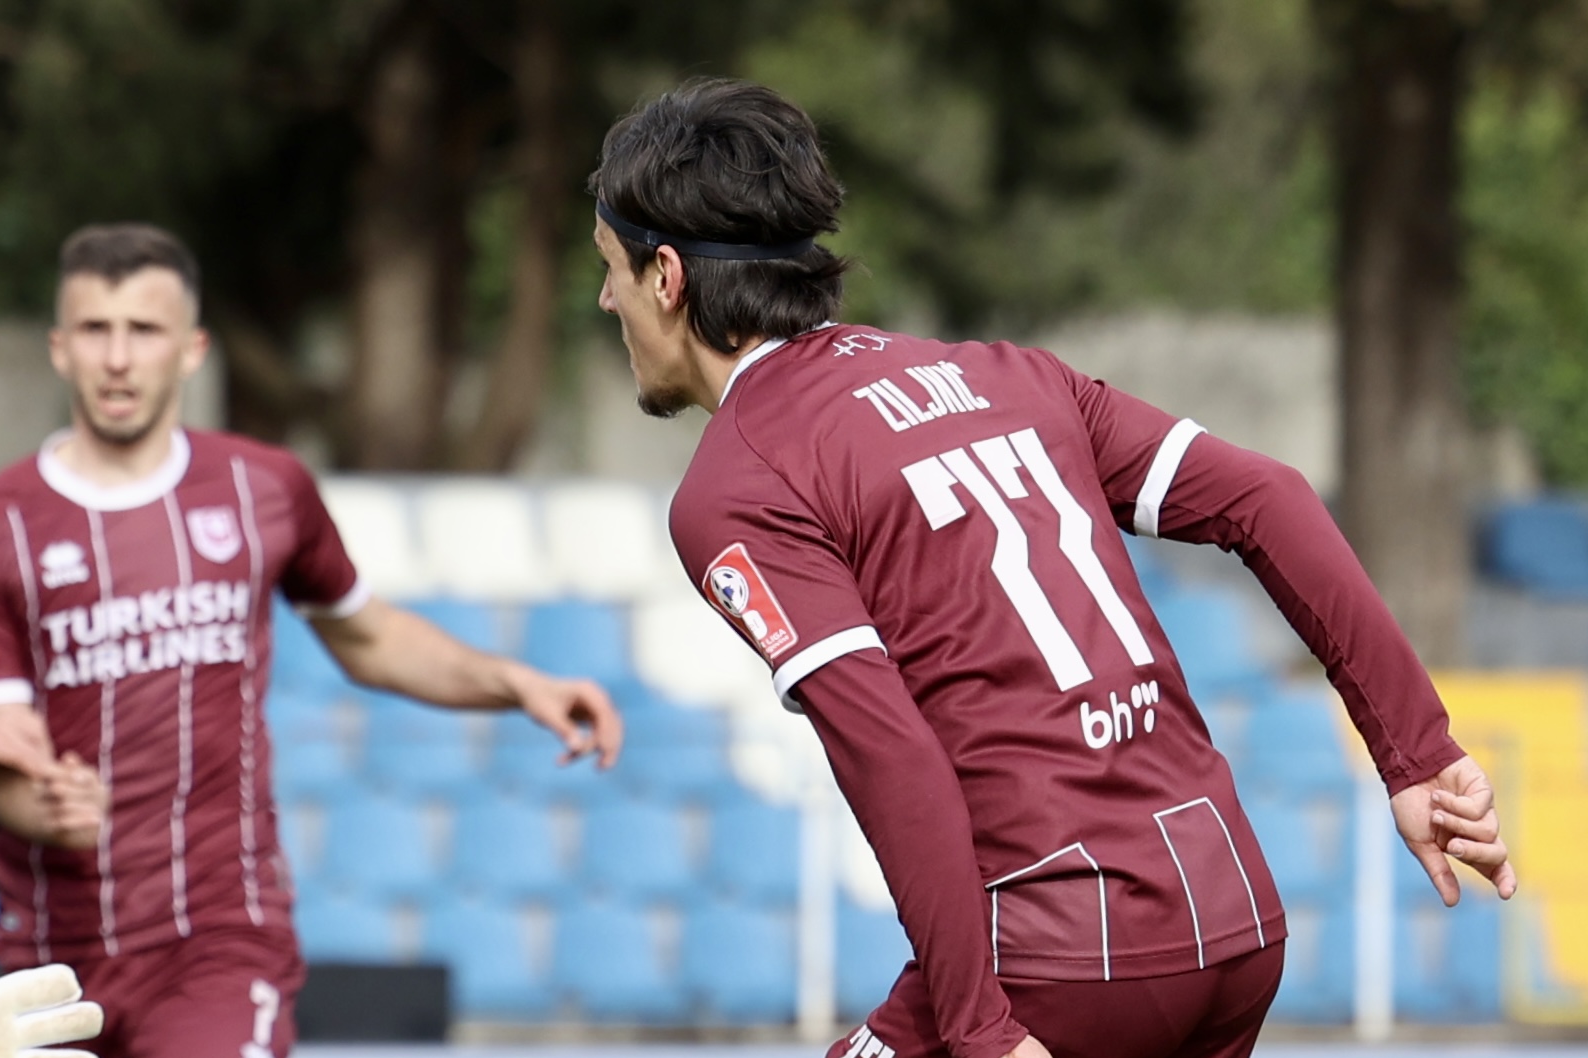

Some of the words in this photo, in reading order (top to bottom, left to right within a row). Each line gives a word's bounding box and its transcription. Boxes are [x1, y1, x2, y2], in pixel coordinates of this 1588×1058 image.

[901, 427, 1154, 692] 77
[42, 580, 250, 653] TURKISH
[44, 622, 248, 690] AIRLINES
[248, 978, 280, 1047] 7
